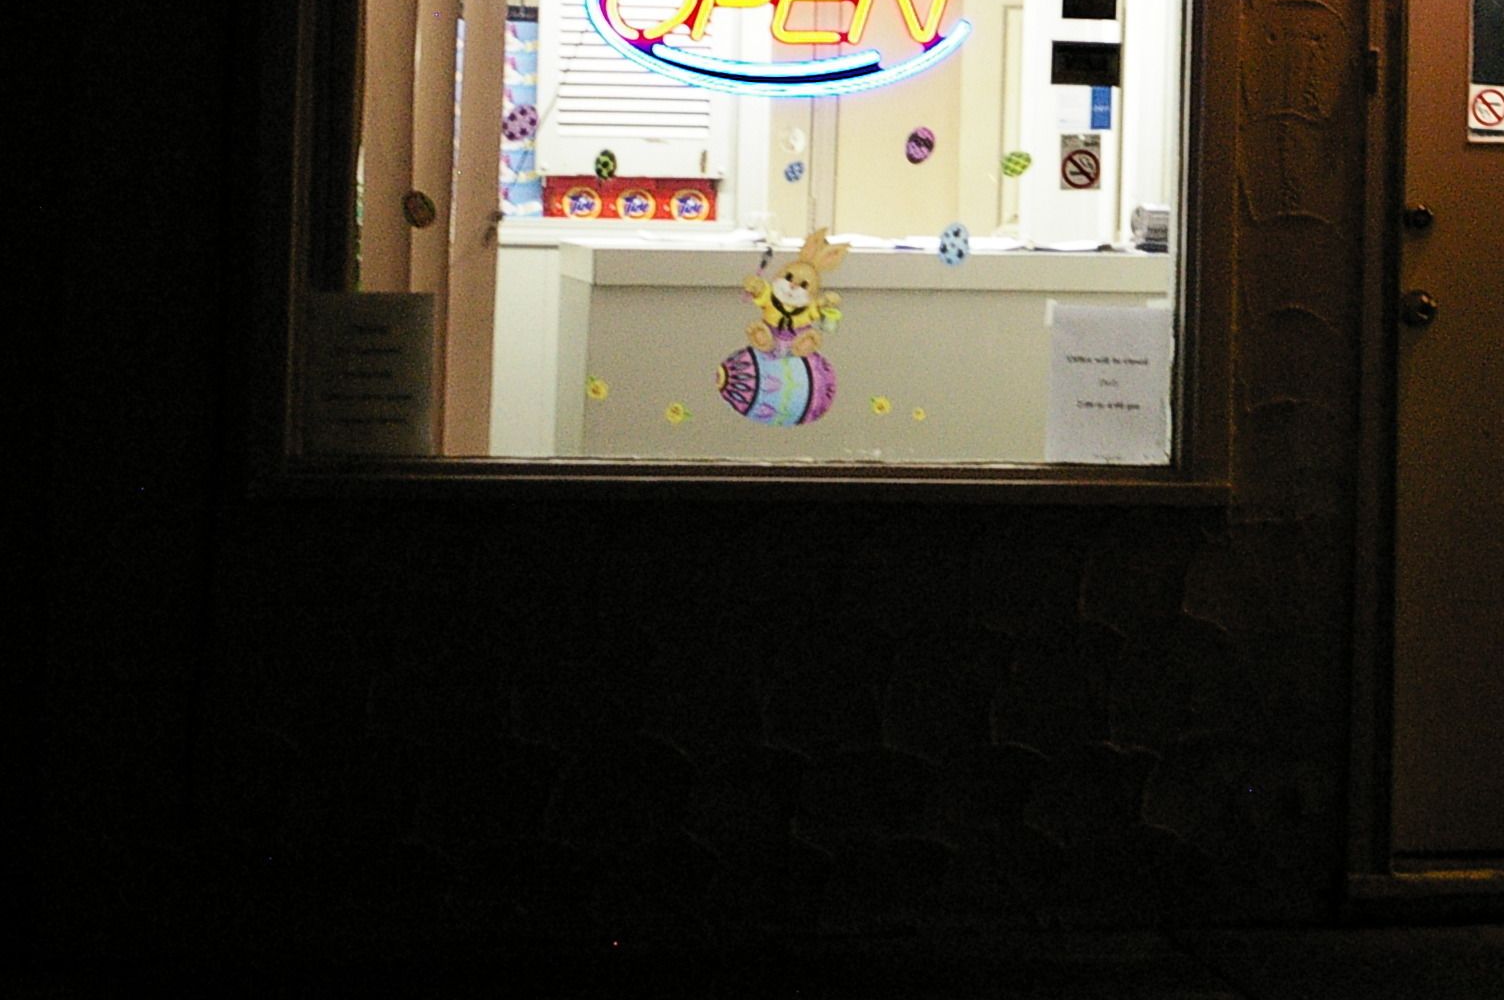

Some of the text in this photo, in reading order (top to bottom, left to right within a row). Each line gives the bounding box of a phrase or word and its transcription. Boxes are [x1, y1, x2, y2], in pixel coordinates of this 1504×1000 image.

[568, 194, 703, 216] Tide Tide Tide
